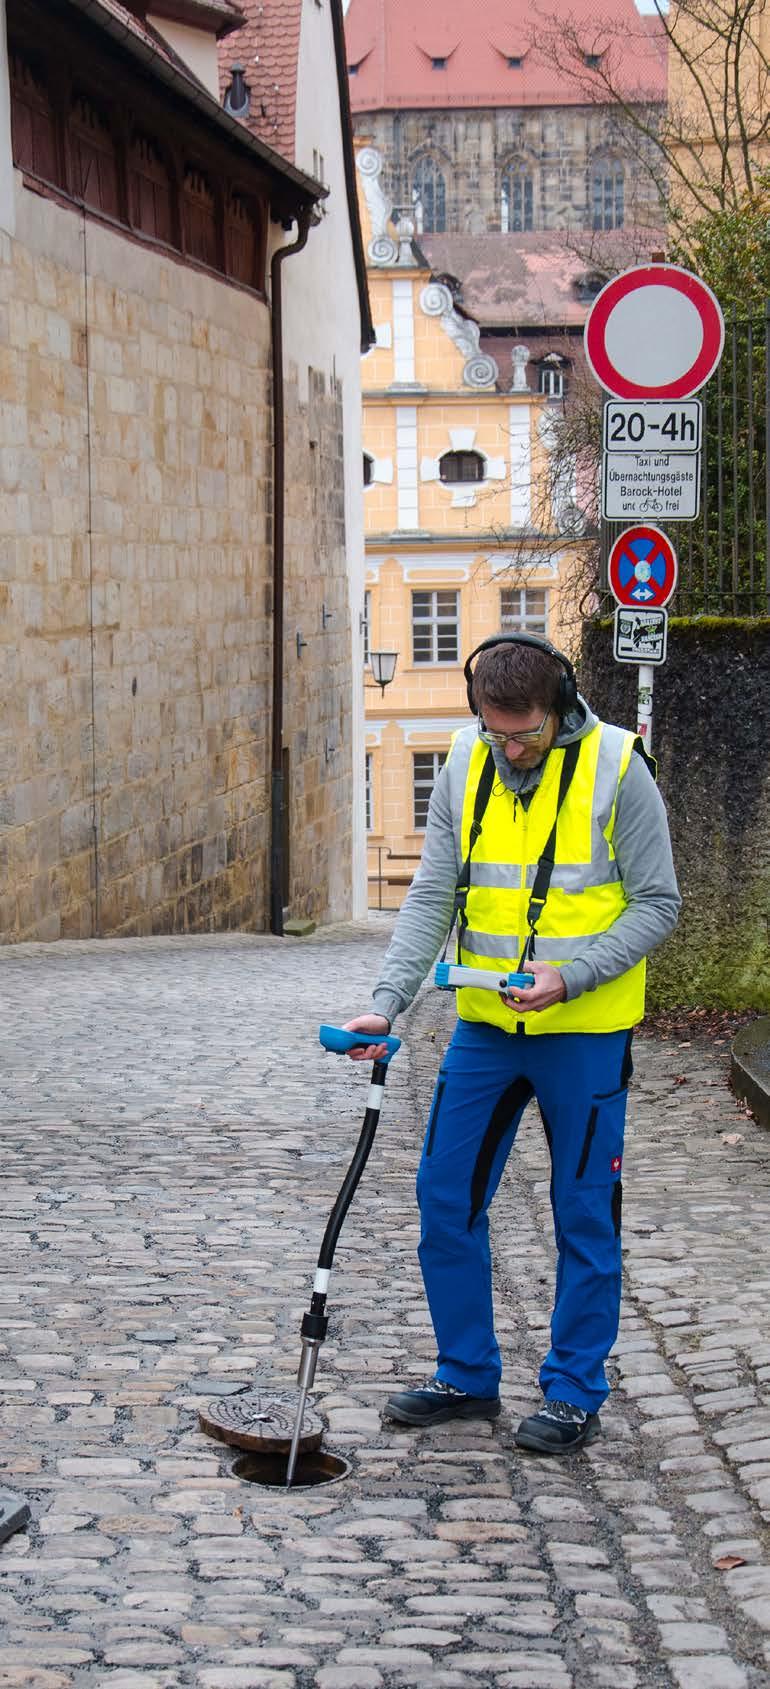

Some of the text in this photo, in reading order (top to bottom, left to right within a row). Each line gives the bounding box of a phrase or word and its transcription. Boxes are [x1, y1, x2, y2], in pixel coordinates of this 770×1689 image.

[610, 412, 695, 442] 20-4h
[635, 455, 670, 466] Taxi und
[609, 469, 694, 483] Übernachtungsgäste
[620, 486, 682, 496] Barock-Hotel
[666, 500, 680, 510] frei
